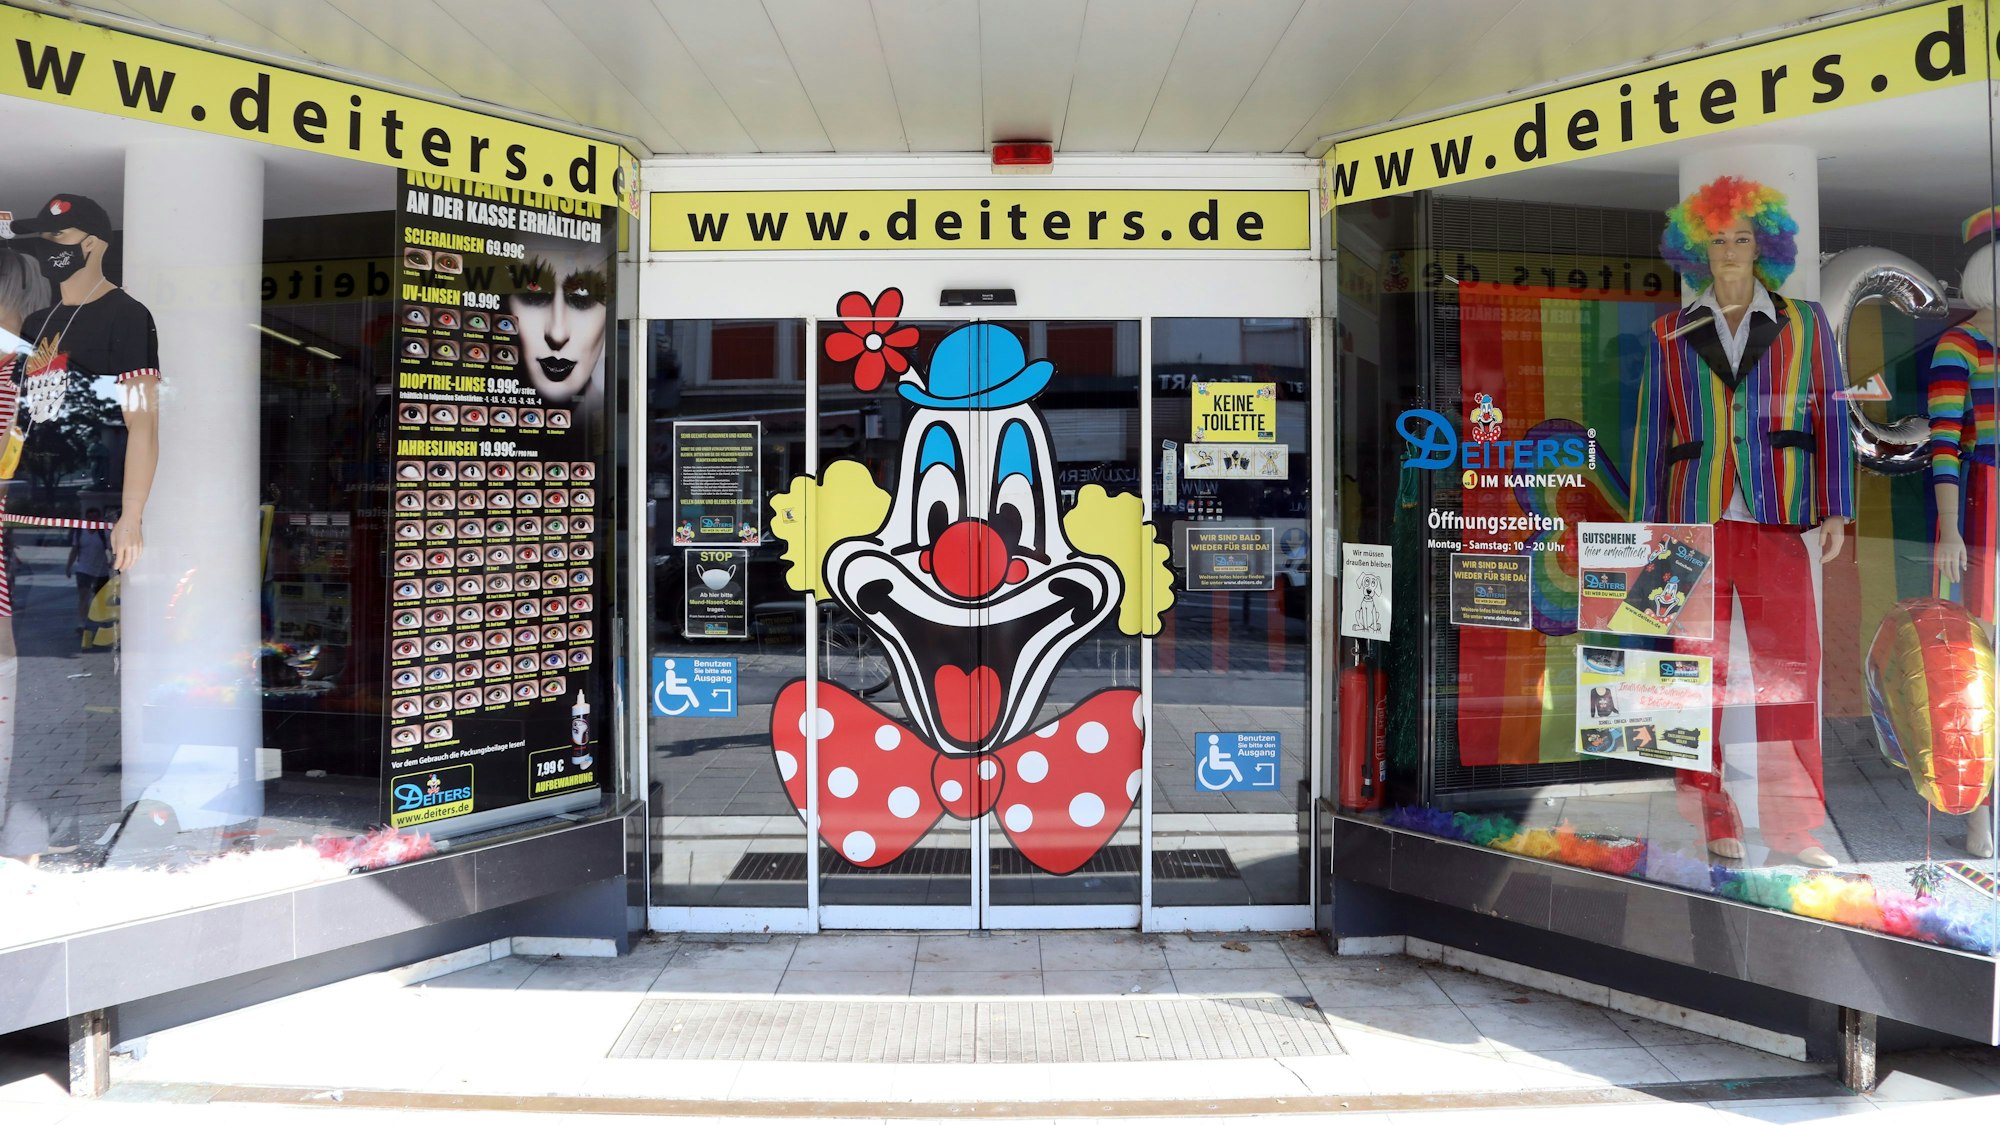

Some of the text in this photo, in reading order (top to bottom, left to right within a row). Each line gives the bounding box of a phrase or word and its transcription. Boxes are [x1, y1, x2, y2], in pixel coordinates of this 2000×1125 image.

[1332, 4, 2000, 198] www.deiters.d
[406, 190, 601, 244] AN DER KASSE ERHÄLTLICH
[687, 199, 1265, 241] www.deiters.de
[404, 227, 525, 260] SCLERALINSEN 69.99€
[402, 283, 500, 311] UV-LINSEN 19.99€
[399, 372, 486, 393] DIOPTRIE-LINSE
[1213, 395, 1254, 412] KEINE
[1202, 414, 1266, 431] TOILETTE
[397, 439, 478, 457] JAHRESLINSEN
[1481, 475, 1499, 488] IM
[1504, 474, 1586, 488] KARNEVAL
[1427, 508, 1565, 535] Öffnungszeiten
[1223, 541, 1240, 551] FÜR
[1427, 539, 1462, 551] Montag
[1469, 539, 1512, 553] Samstag:
[1513, 541, 1524, 551] 10
[1532, 541, 1545, 552] 20
[1547, 541, 1565, 552] Uhr
[1582, 532, 1637, 545] GUTSCHEINE
[700, 551, 733, 562] STOP
[1352, 549, 1363, 557] Wir
[1584, 546, 1601, 558] hier
[1346, 559, 1391, 568] draußen bleiben
[1462, 560, 1519, 570] WIR SIND BALD
[1454, 570, 1527, 582] WIEDER FÜR SIE DA!
[1625, 605, 1661, 629] www.deiters.de
[693, 659, 732, 667] Benutzen
[693, 674, 732, 684] Ausgang
[391, 761, 403, 769] Vor
[403, 757, 418, 768] dem
[419, 753, 449, 765] Gebrauch
[449, 750, 460, 760] die
[460, 744, 508, 758] Packungsbeilage
[508, 739, 526, 749] lesen!
[1238, 749, 1276, 758] Ausgang
[535, 772, 594, 794] AUFBEWAHRUNG
[396, 803, 470, 826] www.deiters.de
